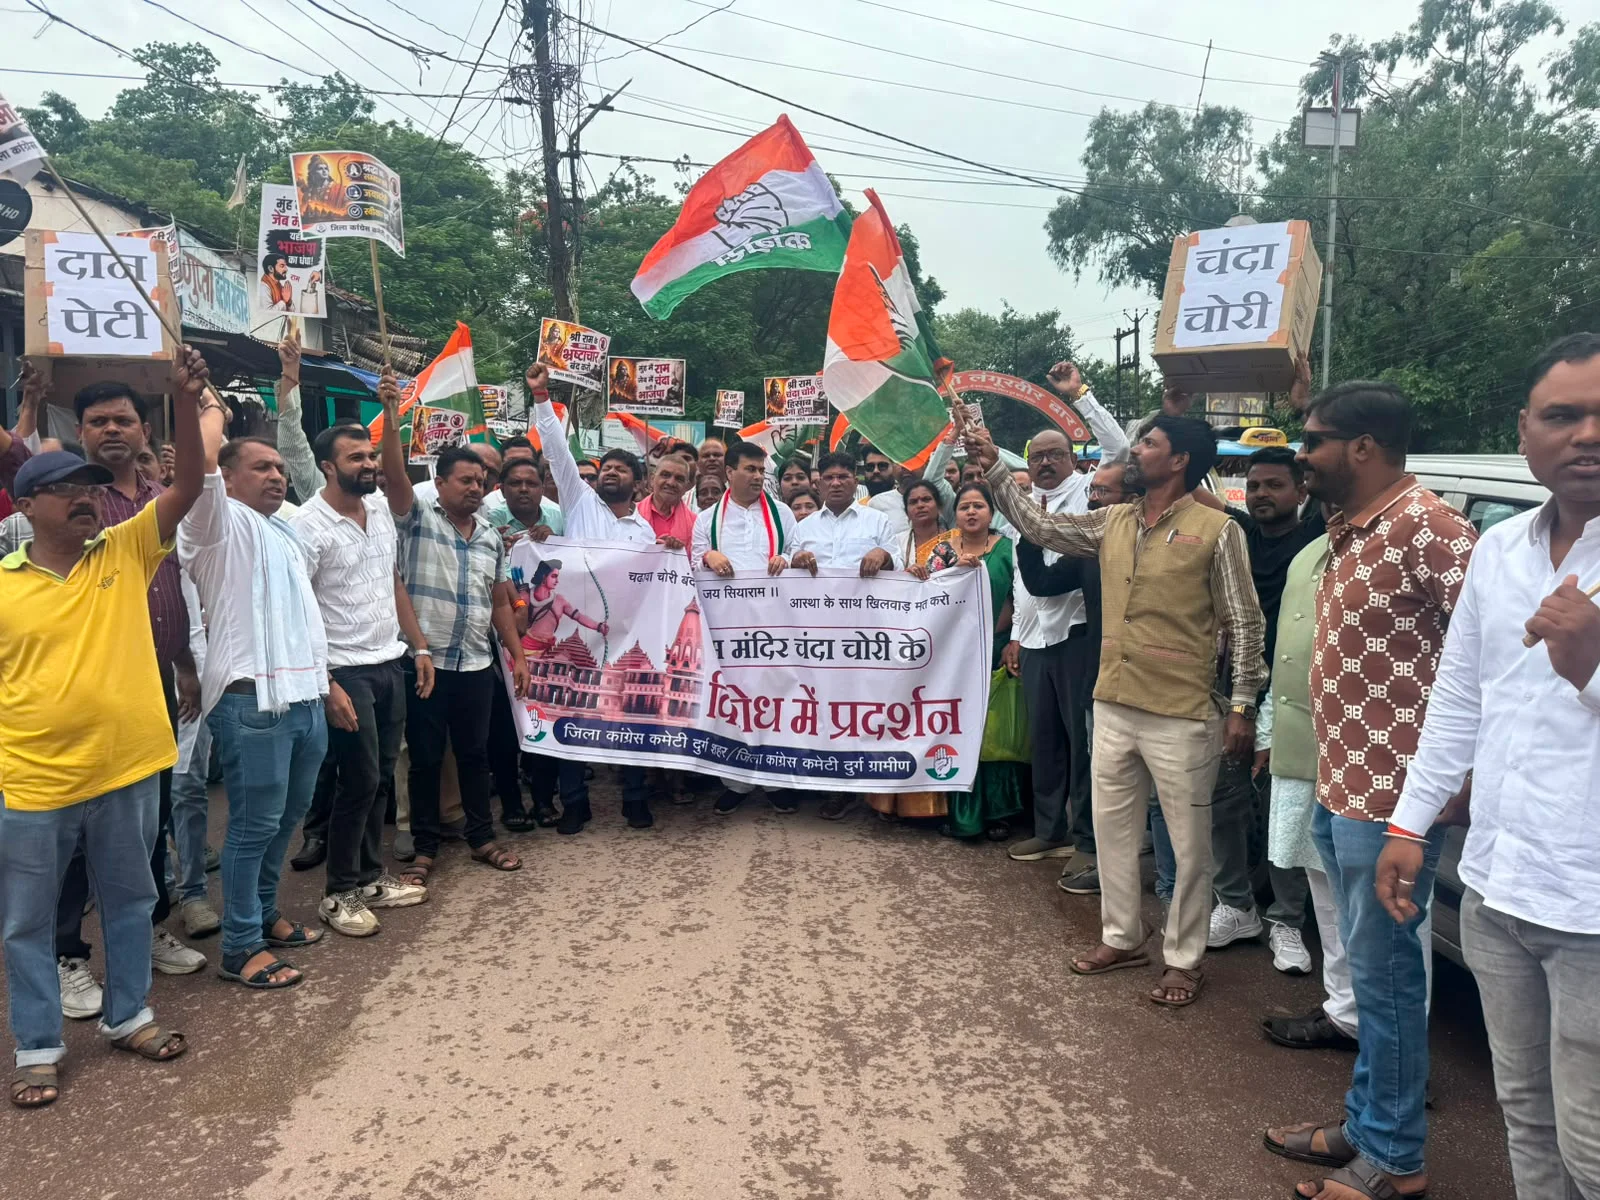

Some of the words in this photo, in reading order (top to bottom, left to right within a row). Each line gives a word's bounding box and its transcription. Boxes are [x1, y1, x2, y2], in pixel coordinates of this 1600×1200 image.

[277, 241, 317, 256] भाजपा
[1196, 238, 1280, 276] चंदा
[54, 249, 148, 282] दान
[61, 297, 148, 340] पेटी
[1184, 291, 1272, 333] चोरी
[582, 334, 594, 344] राम
[654, 364, 670, 374] राम
[655, 375, 670, 386] चंदा
[788, 379, 796, 389] श्री
[798, 379, 812, 388] राम
[638, 390, 665, 399] भाजपा
[786, 390, 800, 398] चंदा
[802, 386, 816, 396] चोरी
[658, 568, 678, 584] चोरी
[702, 589, 720, 600] जय
[724, 586, 765, 598] सियाराम
[790, 598, 820, 610] आस्था
[824, 594, 835, 609] के
[839, 598, 862, 610] साथ
[866, 596, 911, 613] खिलवाड़
[930, 591, 951, 606] करो
[730, 630, 789, 660] मंदिर
[794, 631, 836, 661] चंदा
[842, 630, 892, 661] चोरी
[898, 634, 926, 662] के
[790, 684, 820, 736] में
[828, 685, 962, 740] प्रदर्शन
[564, 724, 601, 742] जिला
[606, 726, 644, 745] कांग्रेस
[649, 730, 688, 749] कमेटी
[693, 737, 709, 755] दुर्ग
[766, 752, 798, 768] कांग्रेस
[802, 756, 839, 773] कमेटी
[844, 757, 864, 776] दुर्ग
[868, 758, 910, 773] ग्रामीण
